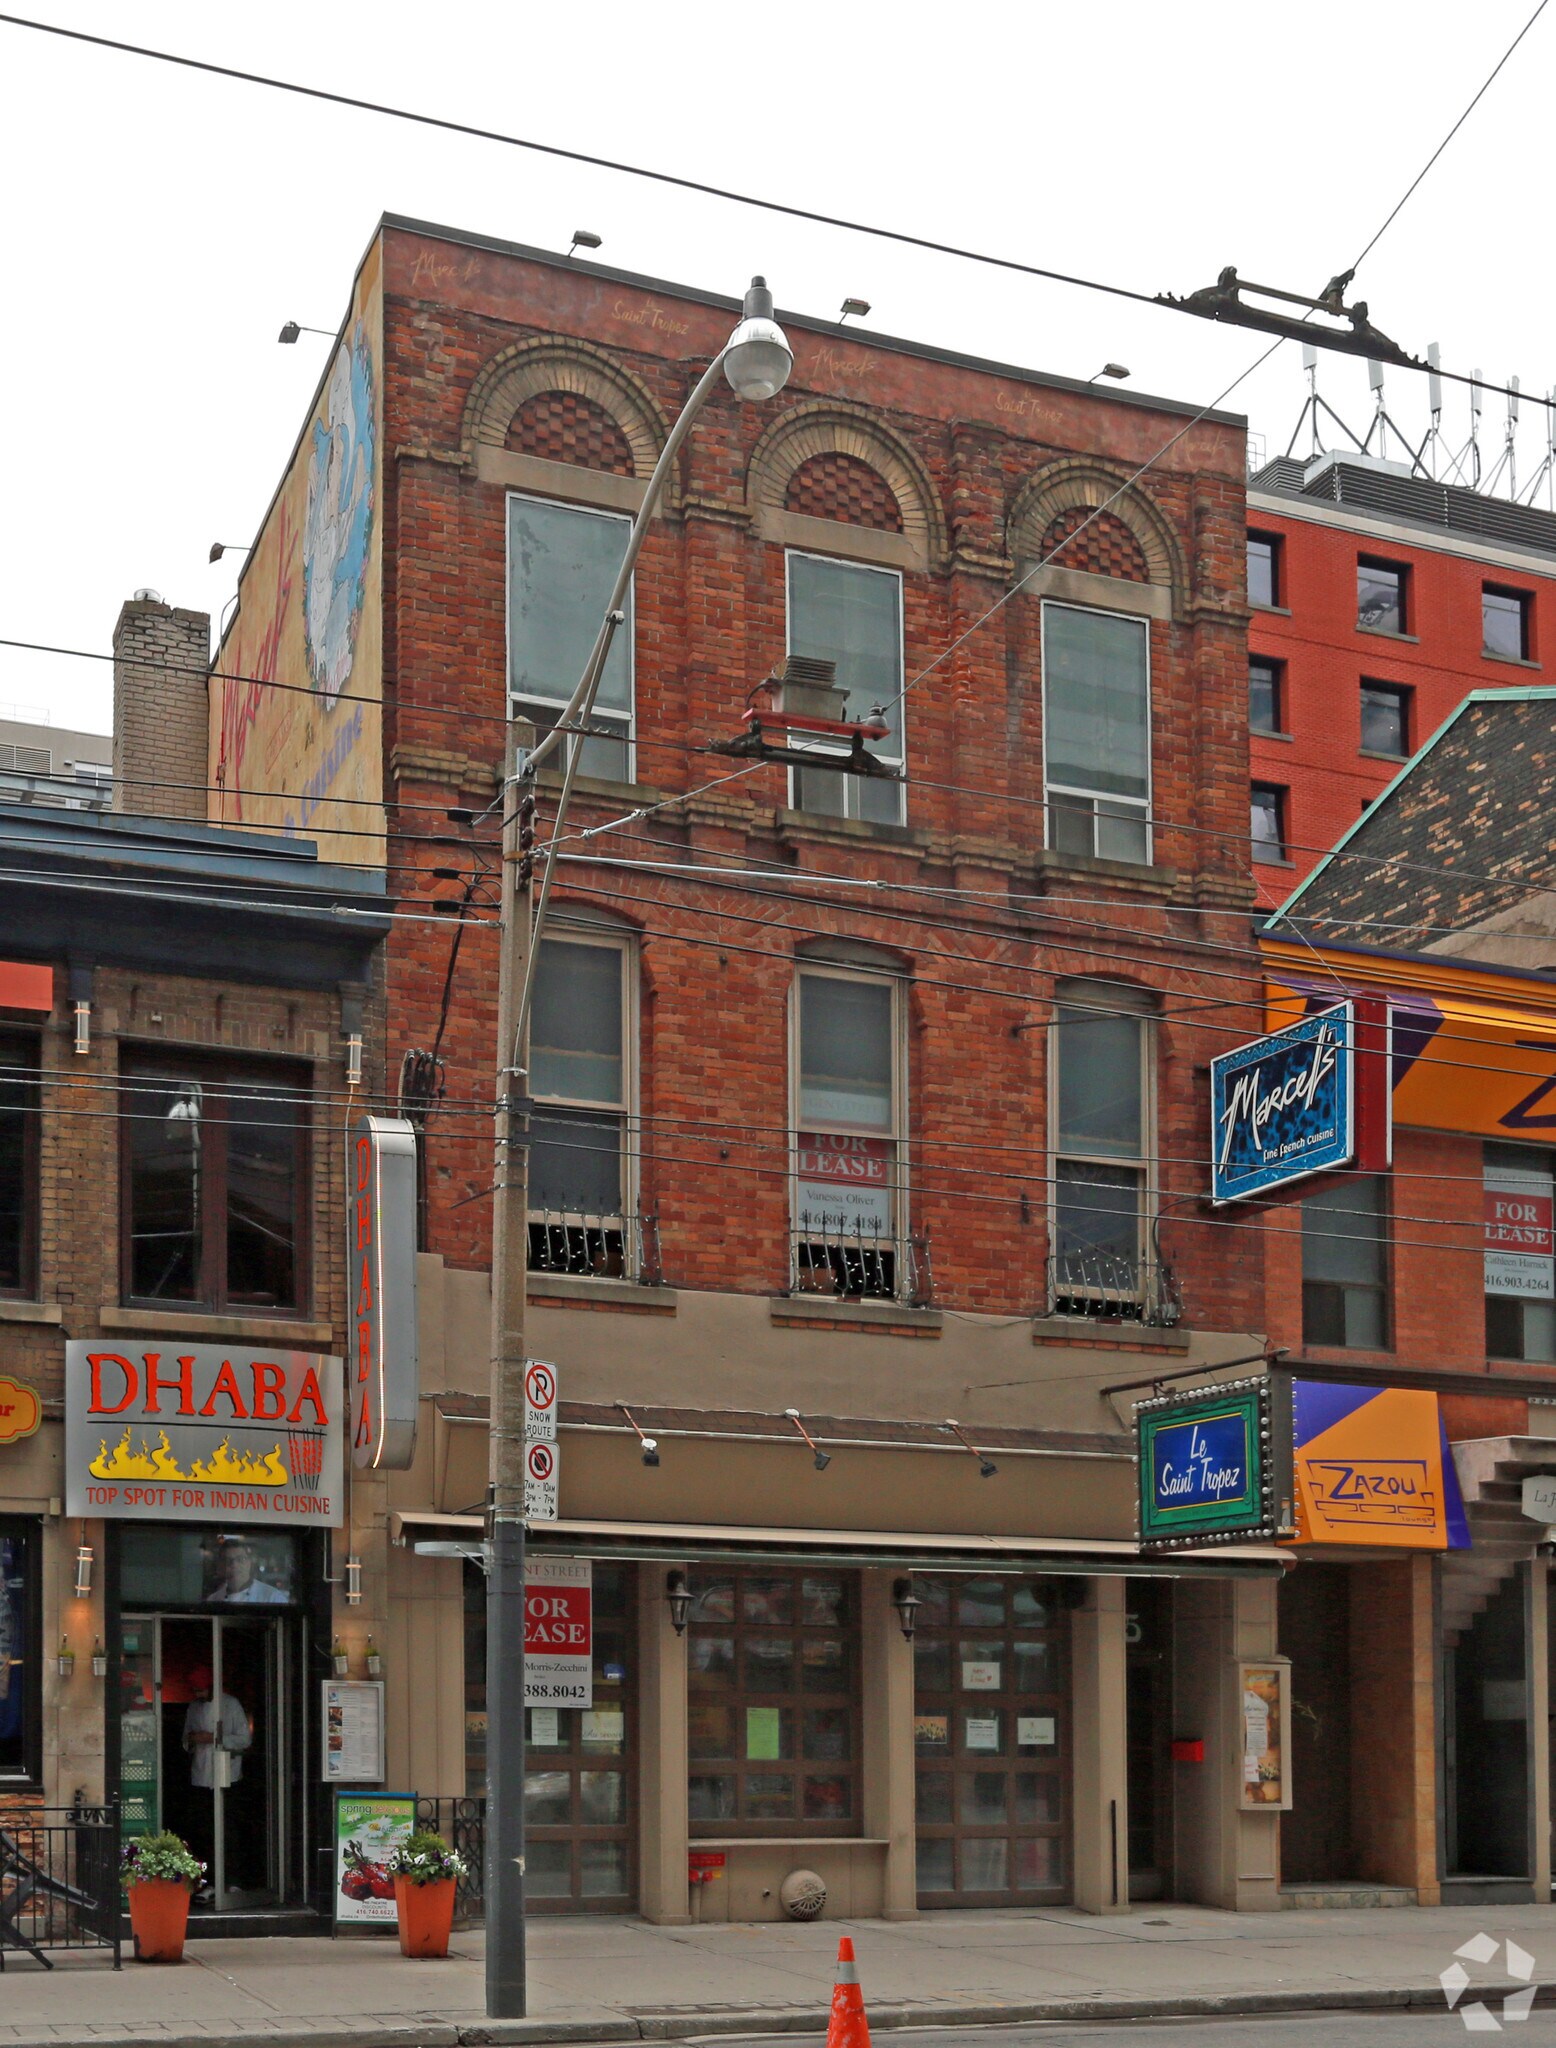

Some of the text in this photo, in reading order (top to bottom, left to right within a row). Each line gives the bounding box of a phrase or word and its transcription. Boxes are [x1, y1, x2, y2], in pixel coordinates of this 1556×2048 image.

[612, 300, 689, 338] Saint Tropez
[994, 392, 1028, 415] Saint
[1219, 1023, 1343, 1175] Marcel's
[815, 1133, 868, 1153] FOR
[800, 1151, 882, 1178] LEASE
[807, 1190, 875, 1206] Vanessa Oliver
[1495, 1202, 1538, 1222] FOR
[1484, 1222, 1549, 1245] LEASE
[354, 1137, 373, 1448] DHABA
[1485, 1275, 1549, 1291] 416.903.4264
[86, 1353, 329, 1425] DHABA
[529, 1411, 551, 1423] SNOW
[527, 1425, 552, 1437] ROUTE
[1190, 1426, 1208, 1459] Le
[1160, 1457, 1240, 1500] Saint Tropez
[86, 1487, 330, 1515] TOP SPOT FOR INDIAN CUISINE
[544, 1564, 589, 1577] STREET
[525, 1597, 571, 1618] OR
[524, 1622, 586, 1644] EASE
[524, 1685, 586, 1699] 388.8042
